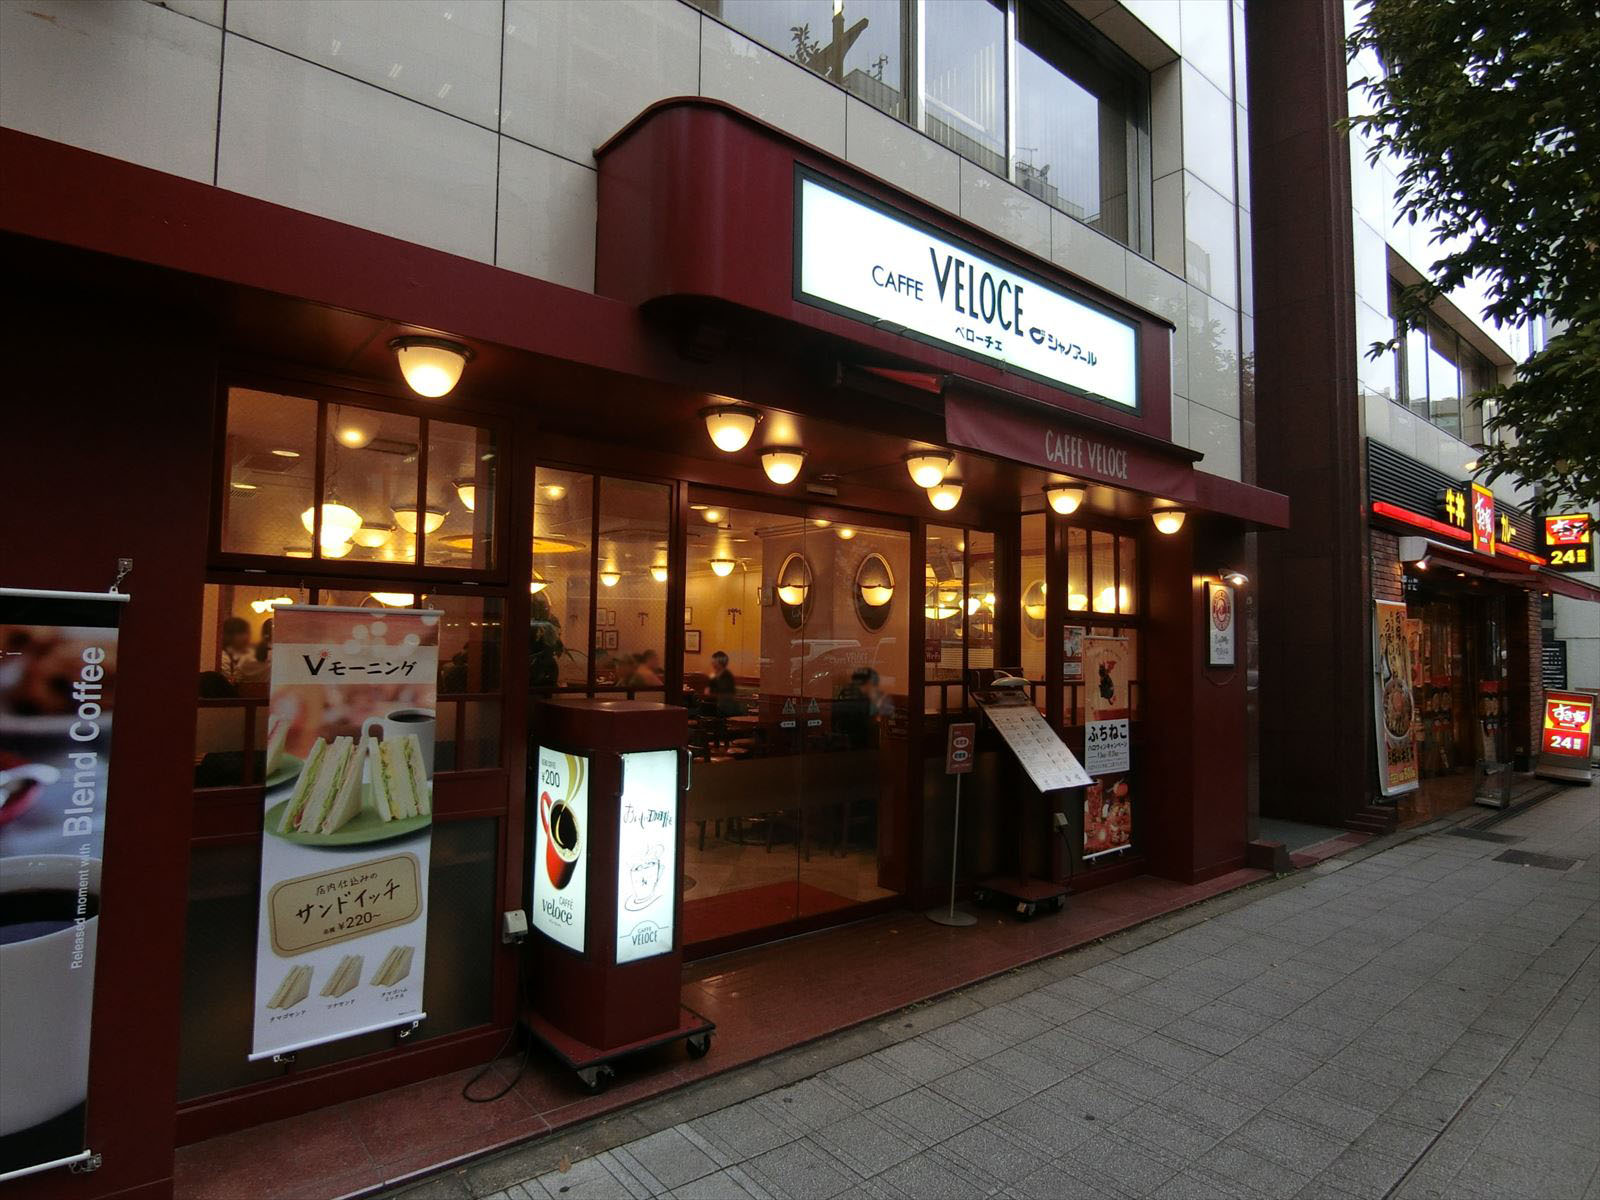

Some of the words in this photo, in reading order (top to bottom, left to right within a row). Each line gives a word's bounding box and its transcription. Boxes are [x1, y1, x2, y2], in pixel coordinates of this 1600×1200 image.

[872, 265, 924, 302] CAFFE
[929, 246, 1024, 337] VELOCE
[1086, 440, 1128, 480] VELOCE
[1446, 487, 1466, 528] 牛丼
[69, 646, 106, 742] Coffee
[1088, 723, 1127, 742] ふちねこ
[62, 752, 98, 837] Blend
[80, 843, 91, 867] with
[77, 869, 90, 915] moment
[295, 878, 401, 925] サンドイッチ
[542, 899, 573, 926] veloce
[71, 917, 86, 969] Released
[631, 930, 658, 946] VELOCE
